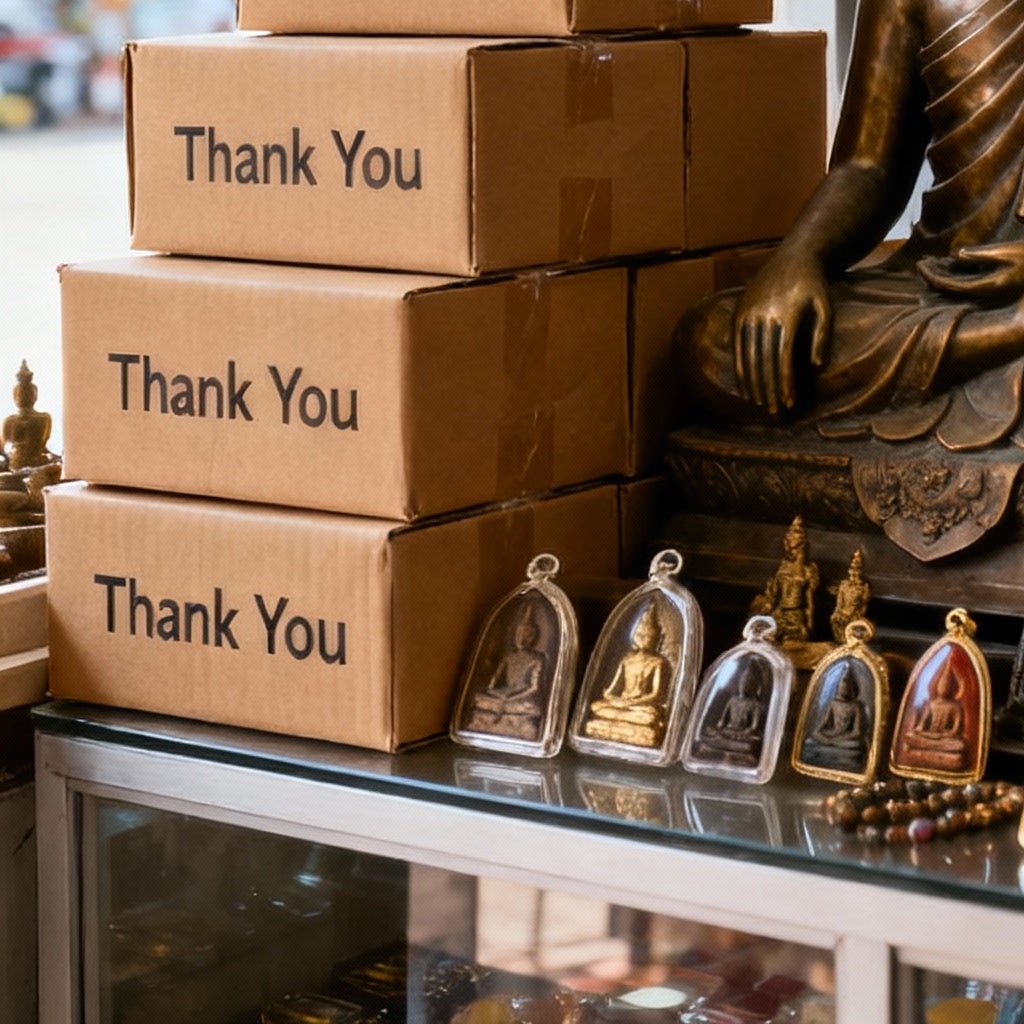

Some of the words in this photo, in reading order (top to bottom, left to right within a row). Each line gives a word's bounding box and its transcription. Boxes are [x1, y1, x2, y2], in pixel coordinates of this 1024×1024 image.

[173, 126, 318, 187] Thank
[330, 129, 423, 191] You
[107, 352, 254, 422] Thank
[267, 365, 359, 432] You
[93, 573, 240, 650] Thank
[253, 593, 347, 666] You
